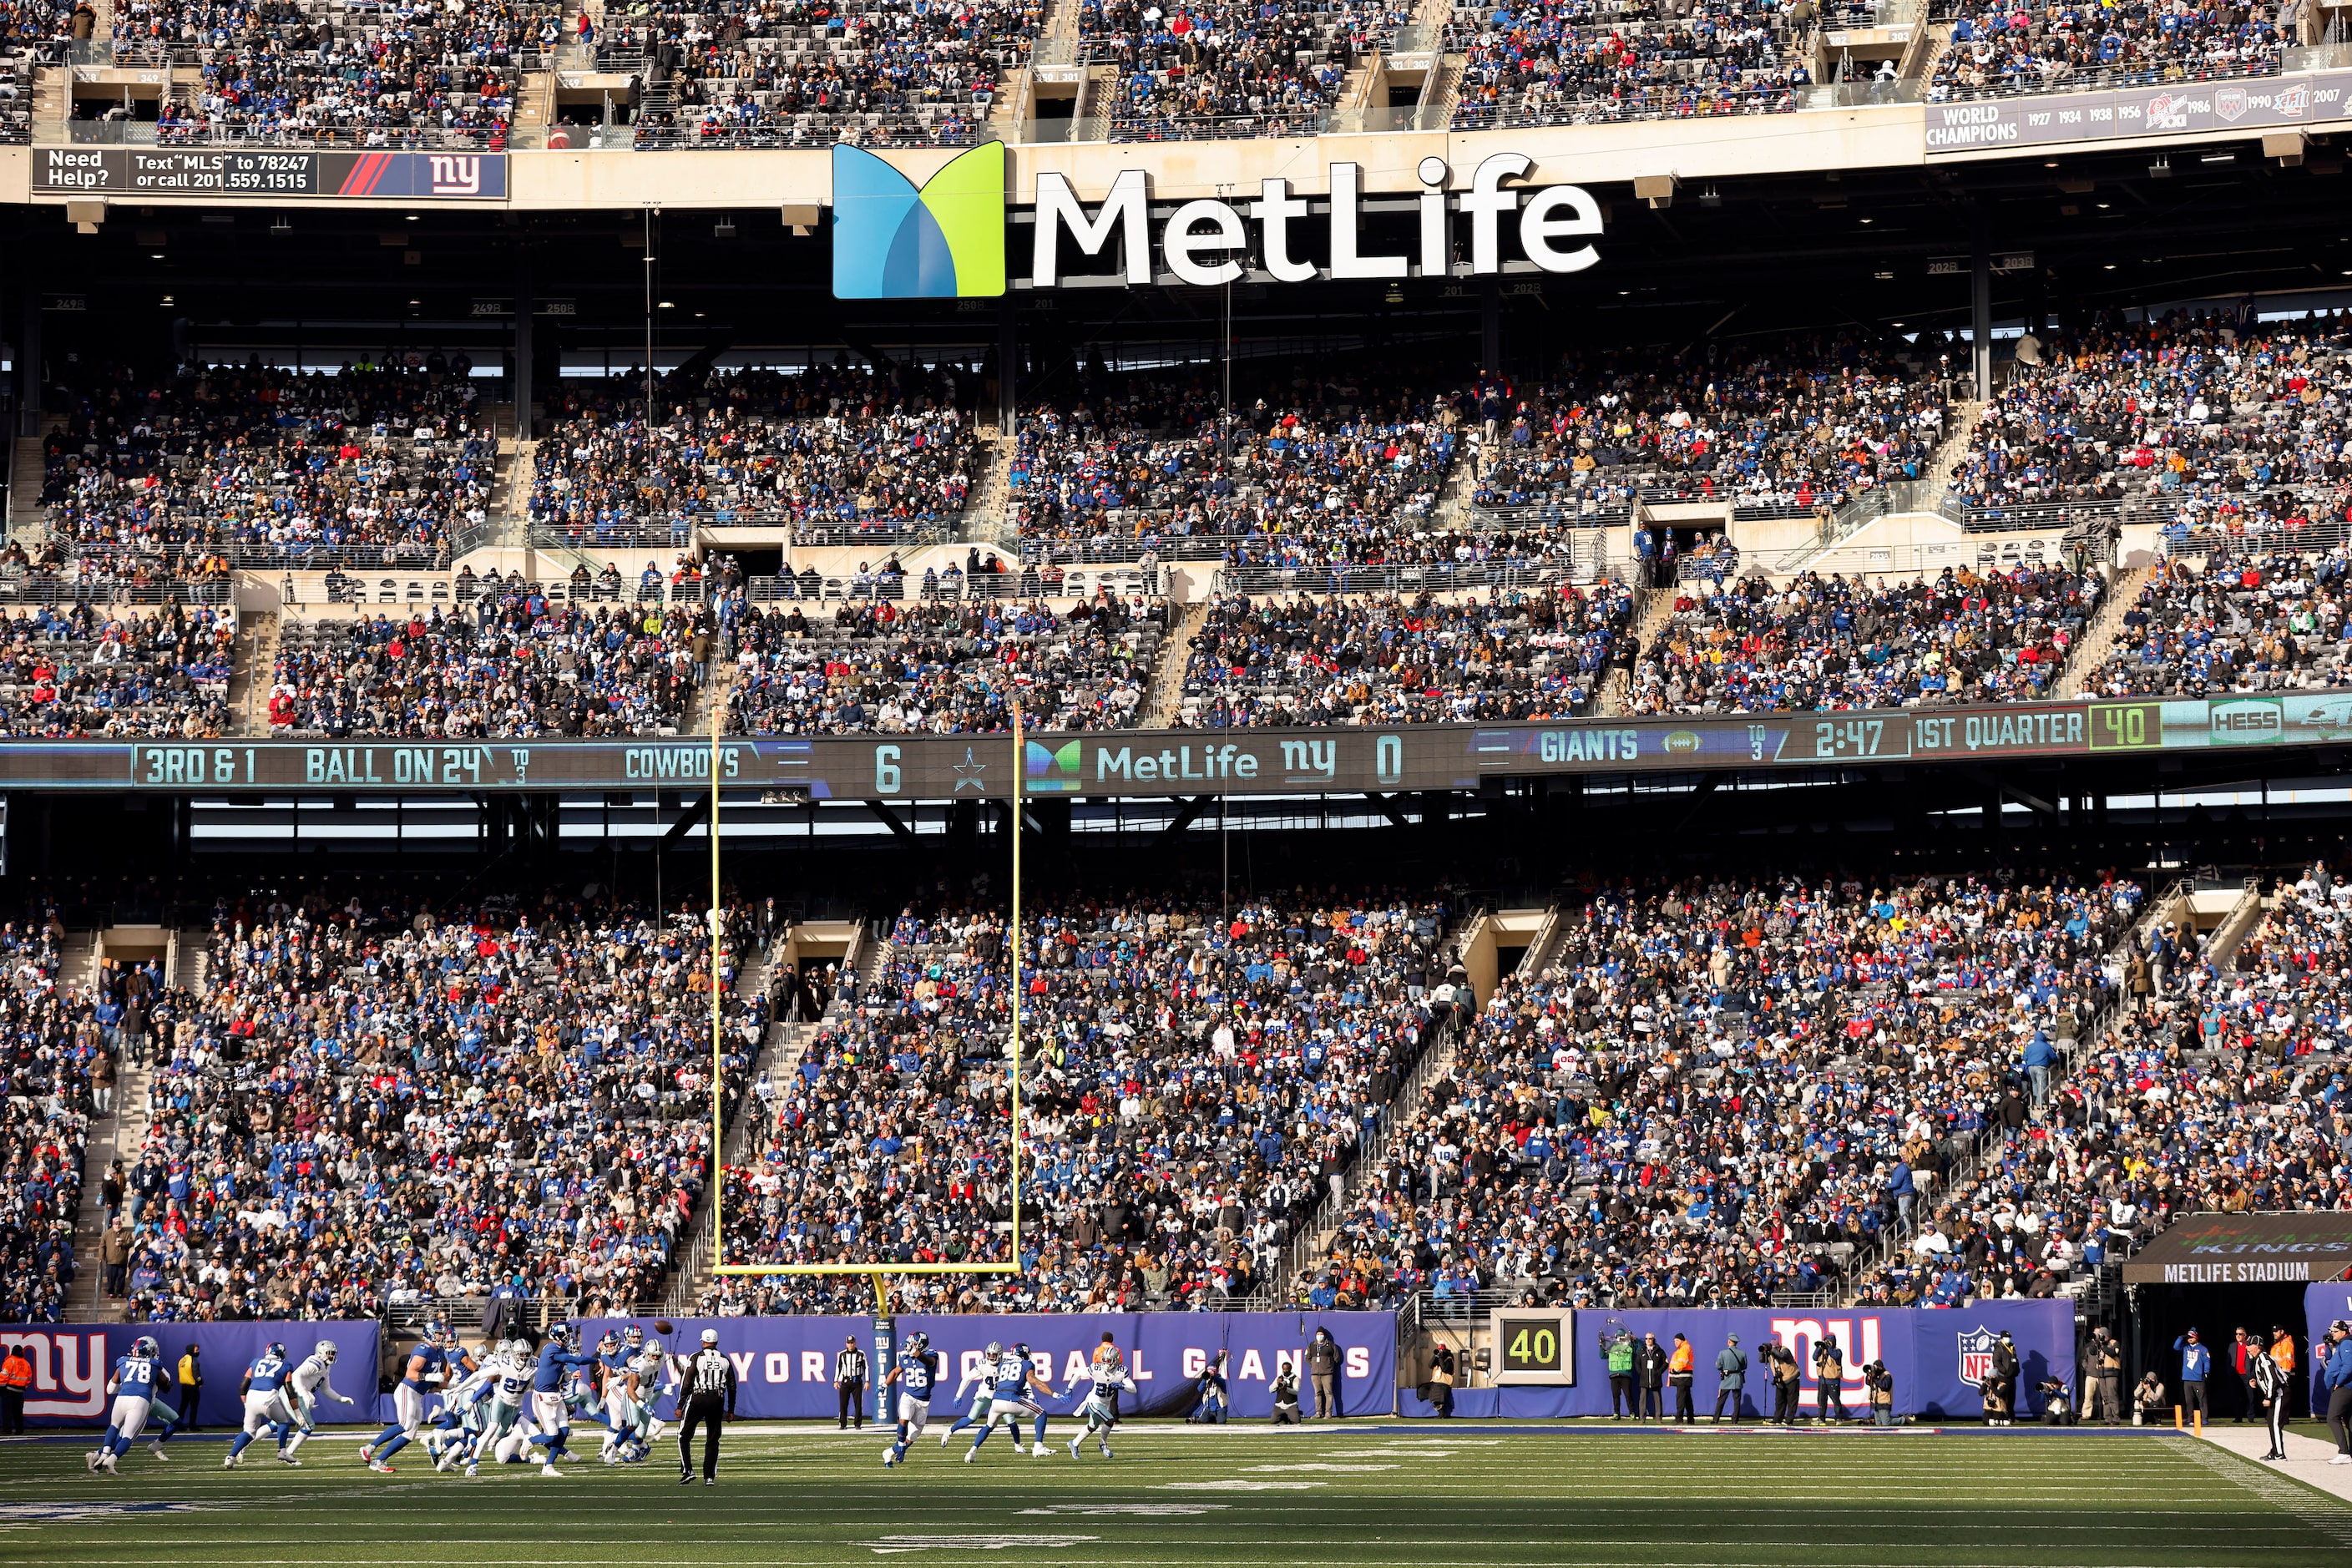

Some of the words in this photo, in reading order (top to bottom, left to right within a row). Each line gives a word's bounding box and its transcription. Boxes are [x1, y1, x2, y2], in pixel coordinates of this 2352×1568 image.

[1829, 36, 1847, 46] 302
[1891, 31, 1909, 41] 303
[1388, 60, 1404, 69] 301
[1413, 59, 1430, 69] 302
[140, 73, 159, 83] 349
[1036, 72, 1054, 82] 350
[1062, 72, 1079, 81] 301
[2247, 94, 2271, 109] 1990
[2272, 90, 2309, 110] XLII
[2313, 89, 2340, 104] 2007
[215, 101, 221, 111] 8
[2117, 105, 2141, 119] 1956
[2188, 100, 2211, 114] 1986
[2220, 99, 2242, 115] XXV
[1943, 106, 1999, 126] WORLD
[2028, 113, 2051, 126] 1927
[2059, 110, 2081, 124] 1934
[2089, 108, 2112, 121] 1938
[2158, 114, 2188, 129] XXI
[1925, 123, 2018, 145] CHAMPIONS
[48, 150, 102, 167] Need
[136, 155, 173, 169] Text
[237, 156, 254, 170] to
[258, 155, 309, 171] 78247
[48, 169, 109, 189] Help?
[137, 175, 155, 187] or
[158, 173, 190, 187] call
[193, 172, 307, 190] 201.559.1515
[429, 155, 480, 194] ny
[1033, 152, 1604, 286] MetLife
[1929, 261, 1957, 272] 202B
[2004, 256, 2034, 267] 203B
[1444, 286, 1463, 296] 201
[1514, 282, 1541, 293] 202B
[56, 299, 85, 309] 249B
[473, 303, 501, 313] 249B
[547, 303, 574, 313] 250B
[957, 301, 984, 310] 250B
[1034, 298, 1053, 308] 201
[387, 356, 392, 365] 4
[1841, 429, 1846, 438] 4
[1401, 458, 1407, 466] 4
[1643, 534, 1653, 545] 10
[1459, 552, 1465, 560] 9
[1870, 552, 1889, 560] 203A
[483, 606, 491, 616] 11
[1035, 675, 1043, 684] 11
[1457, 703, 1466, 713] 21
[2105, 708, 2145, 746] 40
[2214, 710, 2279, 731] HESS
[1748, 724, 1766, 742] TO
[1916, 718, 1956, 749] 1ST
[1965, 712, 2083, 751] QUARTER
[1816, 720, 1884, 758] 2:47
[1540, 729, 1638, 763] GIANTS
[1751, 741, 1763, 761] 3
[511, 749, 529, 766] TO
[625, 747, 740, 780] COWBOYS
[1097, 743, 1259, 782] MetLife
[1280, 740, 1336, 783] ny
[1376, 735, 1402, 785] 0
[146, 748, 205, 783] 3RD
[214, 748, 236, 782] &
[245, 748, 255, 783] 1
[306, 748, 382, 783] BALL
[393, 748, 434, 783] ON
[443, 748, 481, 783] 24
[875, 745, 902, 794] 6
[515, 766, 526, 784] 3
[2337, 893, 2347, 903] 90
[621, 934, 628, 943] 2
[1698, 1011, 1711, 1021] 24
[1308, 1048, 1322, 1060] 26
[758, 1088, 768, 1097] 88
[1221, 1105, 1233, 1117] 26
[1415, 1137, 1425, 1146] 21
[1439, 1151, 1450, 1161] 18
[215, 1181, 228, 1194] 27
[1080, 1181, 1090, 1194] 11
[1037, 1196, 1044, 1207] 9
[1274, 1191, 1281, 1201] 4
[2117, 1211, 2123, 1222] 4
[841, 1231, 852, 1242] 10
[2190, 1242, 2352, 1254] KINGS
[2164, 1263, 2232, 1283] METLIFE
[2237, 1262, 2309, 1282] STADIUM
[874, 1337, 889, 1349] ny
[1509, 1328, 1556, 1363] 40
[254, 1360, 284, 1378] 67
[706, 1361, 721, 1370] 23
[728, 1349, 840, 1383] YOR
[1182, 1346, 1369, 1379] GIANS
[1965, 1353, 1990, 1378] NF
[124, 1361, 152, 1384] 78
[905, 1368, 928, 1388] 26
[998, 1362, 1022, 1382] 88
[311, 1378, 325, 1393] 9
[503, 1378, 531, 1394] 27
[644, 1372, 659, 1388] 11
